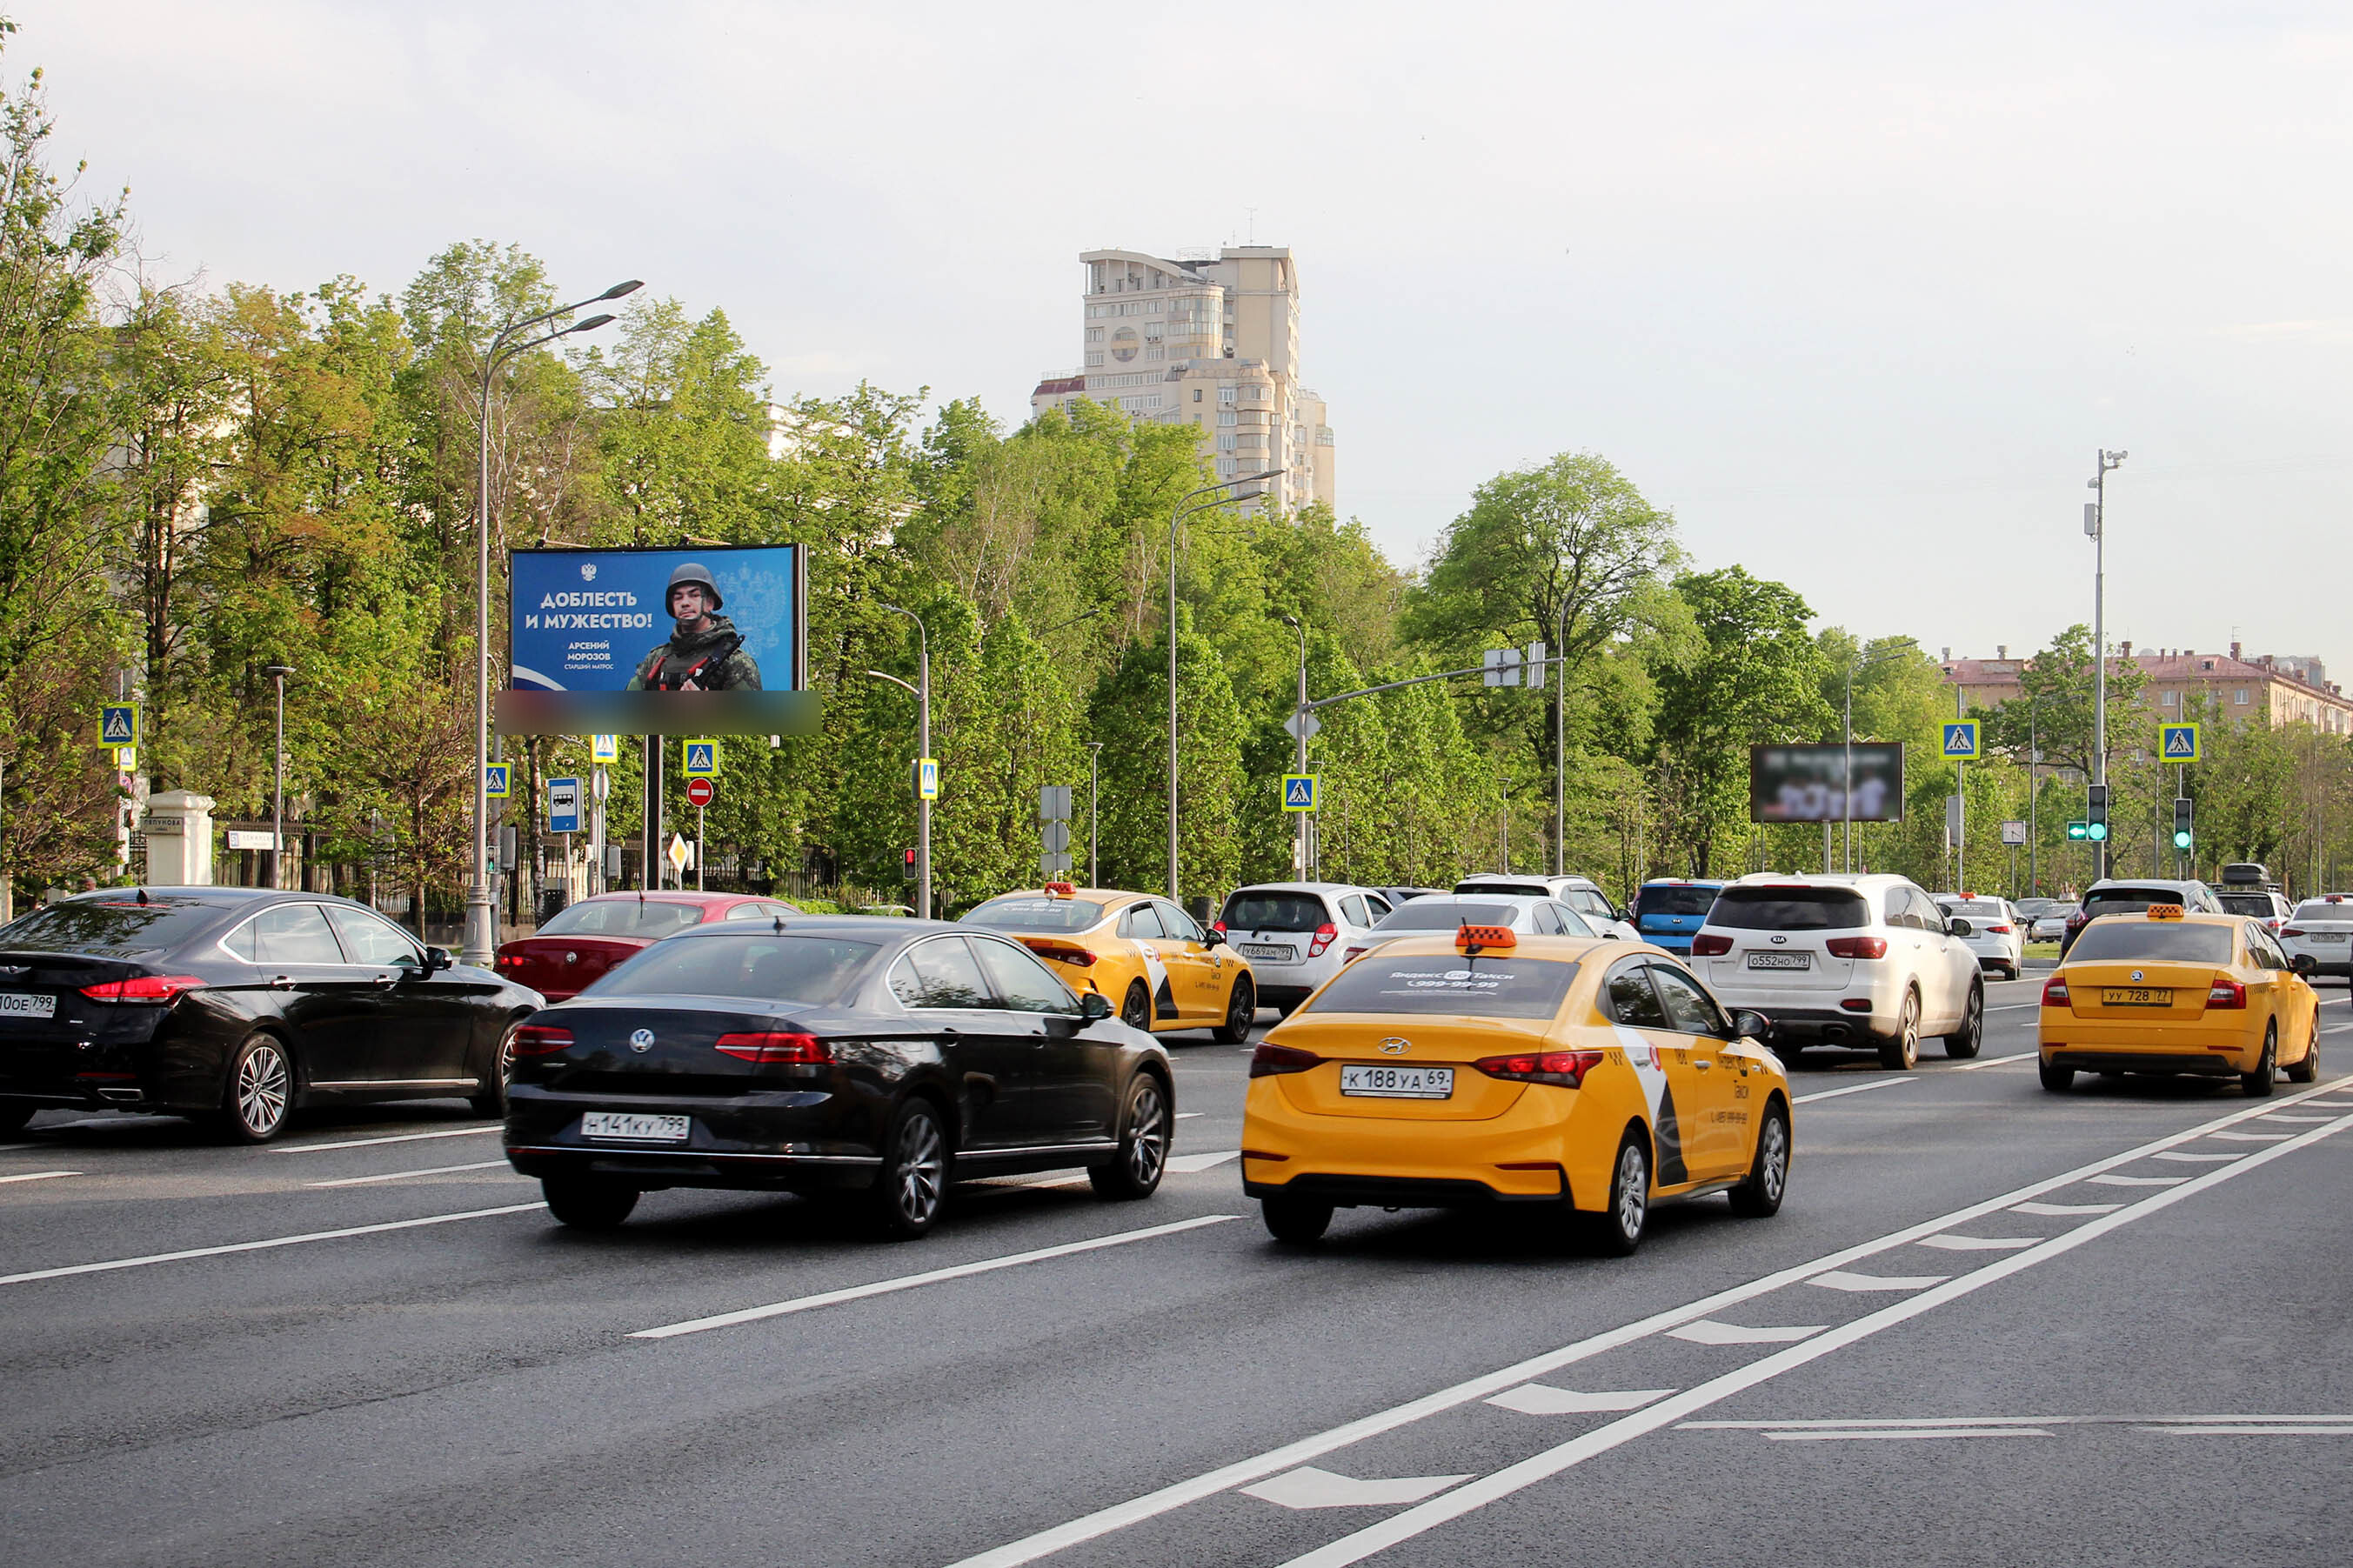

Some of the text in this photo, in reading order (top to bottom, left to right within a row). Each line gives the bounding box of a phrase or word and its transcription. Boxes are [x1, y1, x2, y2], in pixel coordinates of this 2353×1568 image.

[540, 591, 638, 609] ДОБЛЕСТЬ
[525, 613, 652, 629] И МУЖЕСТВО!
[568, 639, 610, 651] АРСЕНИЙ
[1752, 955, 1789, 965] О552НО
[32, 997, 53, 1008] 799
[1427, 1071, 1447, 1084] 69
[585, 1114, 686, 1134] Н141КУ 799
